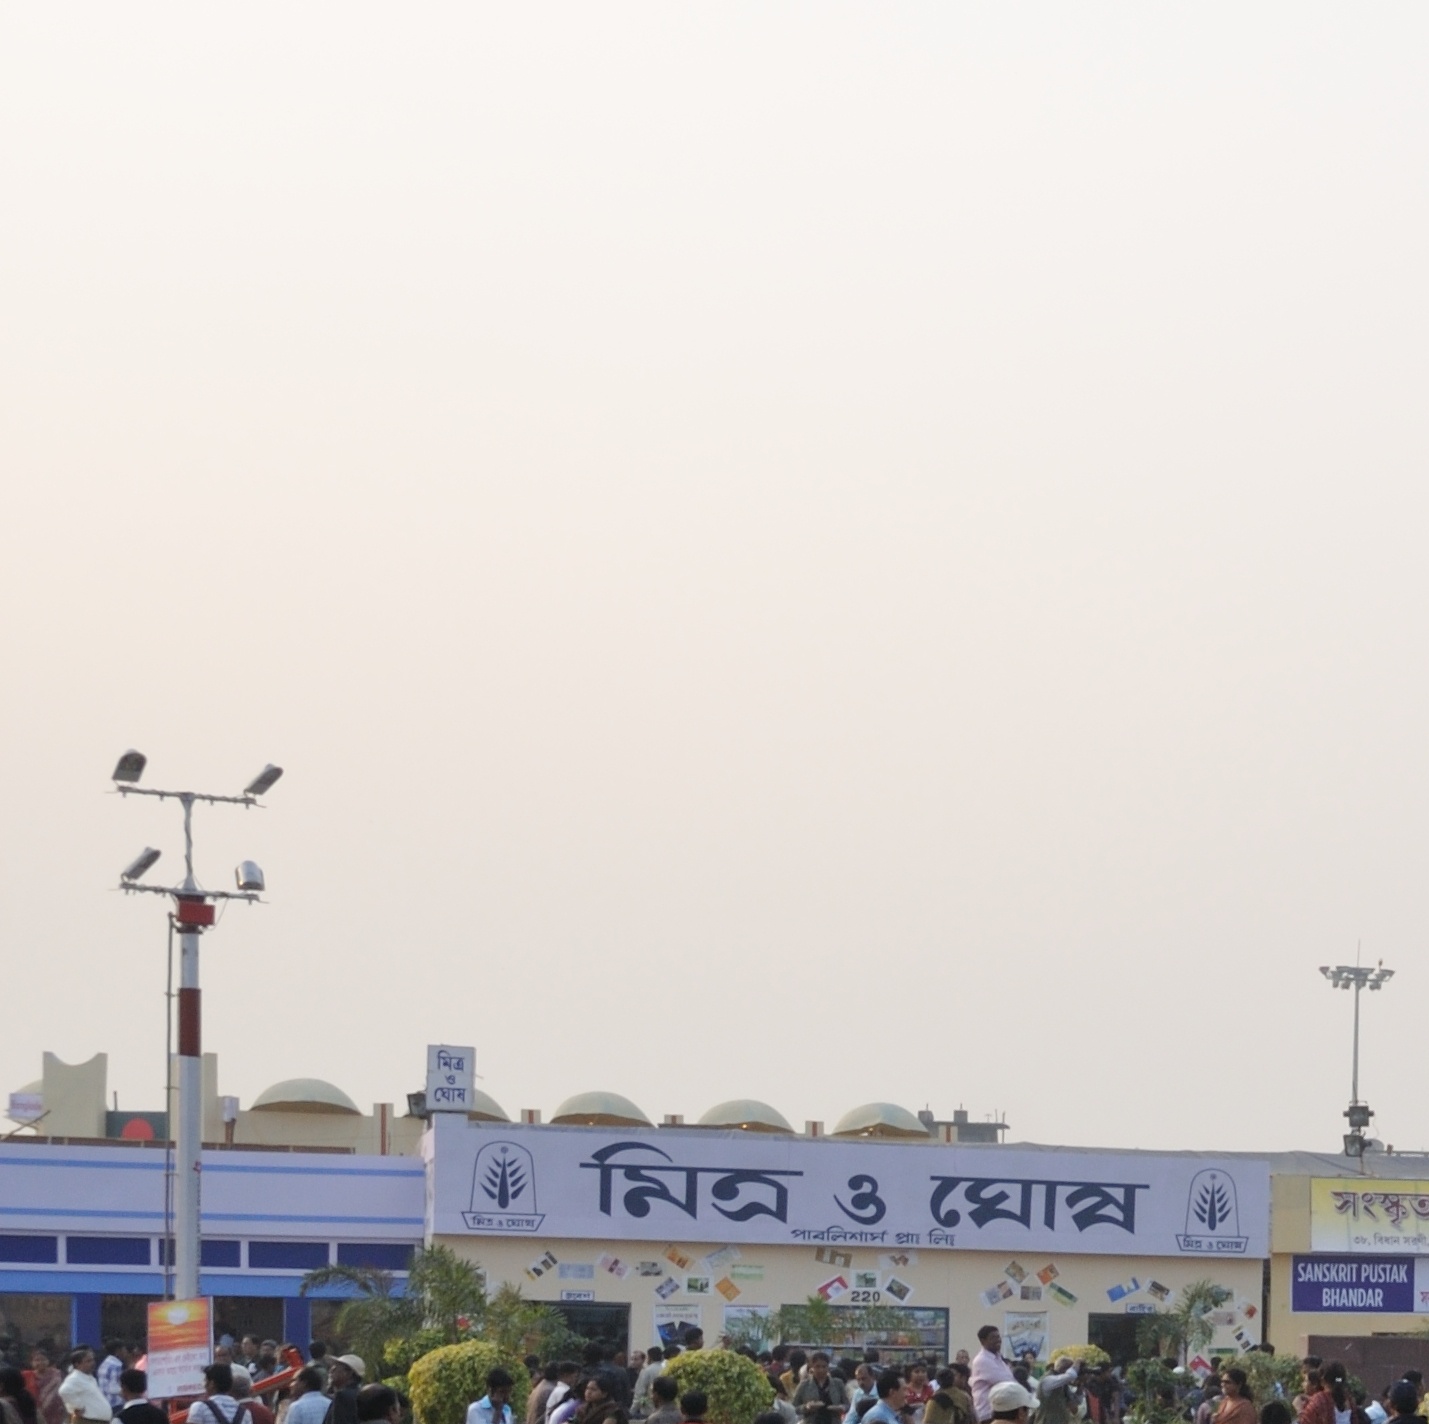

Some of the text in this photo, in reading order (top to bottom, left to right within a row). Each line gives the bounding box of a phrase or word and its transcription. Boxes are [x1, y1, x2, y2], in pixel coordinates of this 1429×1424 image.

[437, 1050, 465, 1071] মিত্র
[445, 1075, 456, 1085] ও
[435, 1087, 466, 1102] ঘোষ
[580, 1141, 1150, 1235] মিত্র ও ঘোষ
[791, 1225, 888, 1243] পাবলিশার্স
[1297, 1262, 1408, 1284] SANSKRIT PUSTAK
[851, 1290, 881, 1303] 220
[1322, 1288, 1383, 1307] BHANDAR
